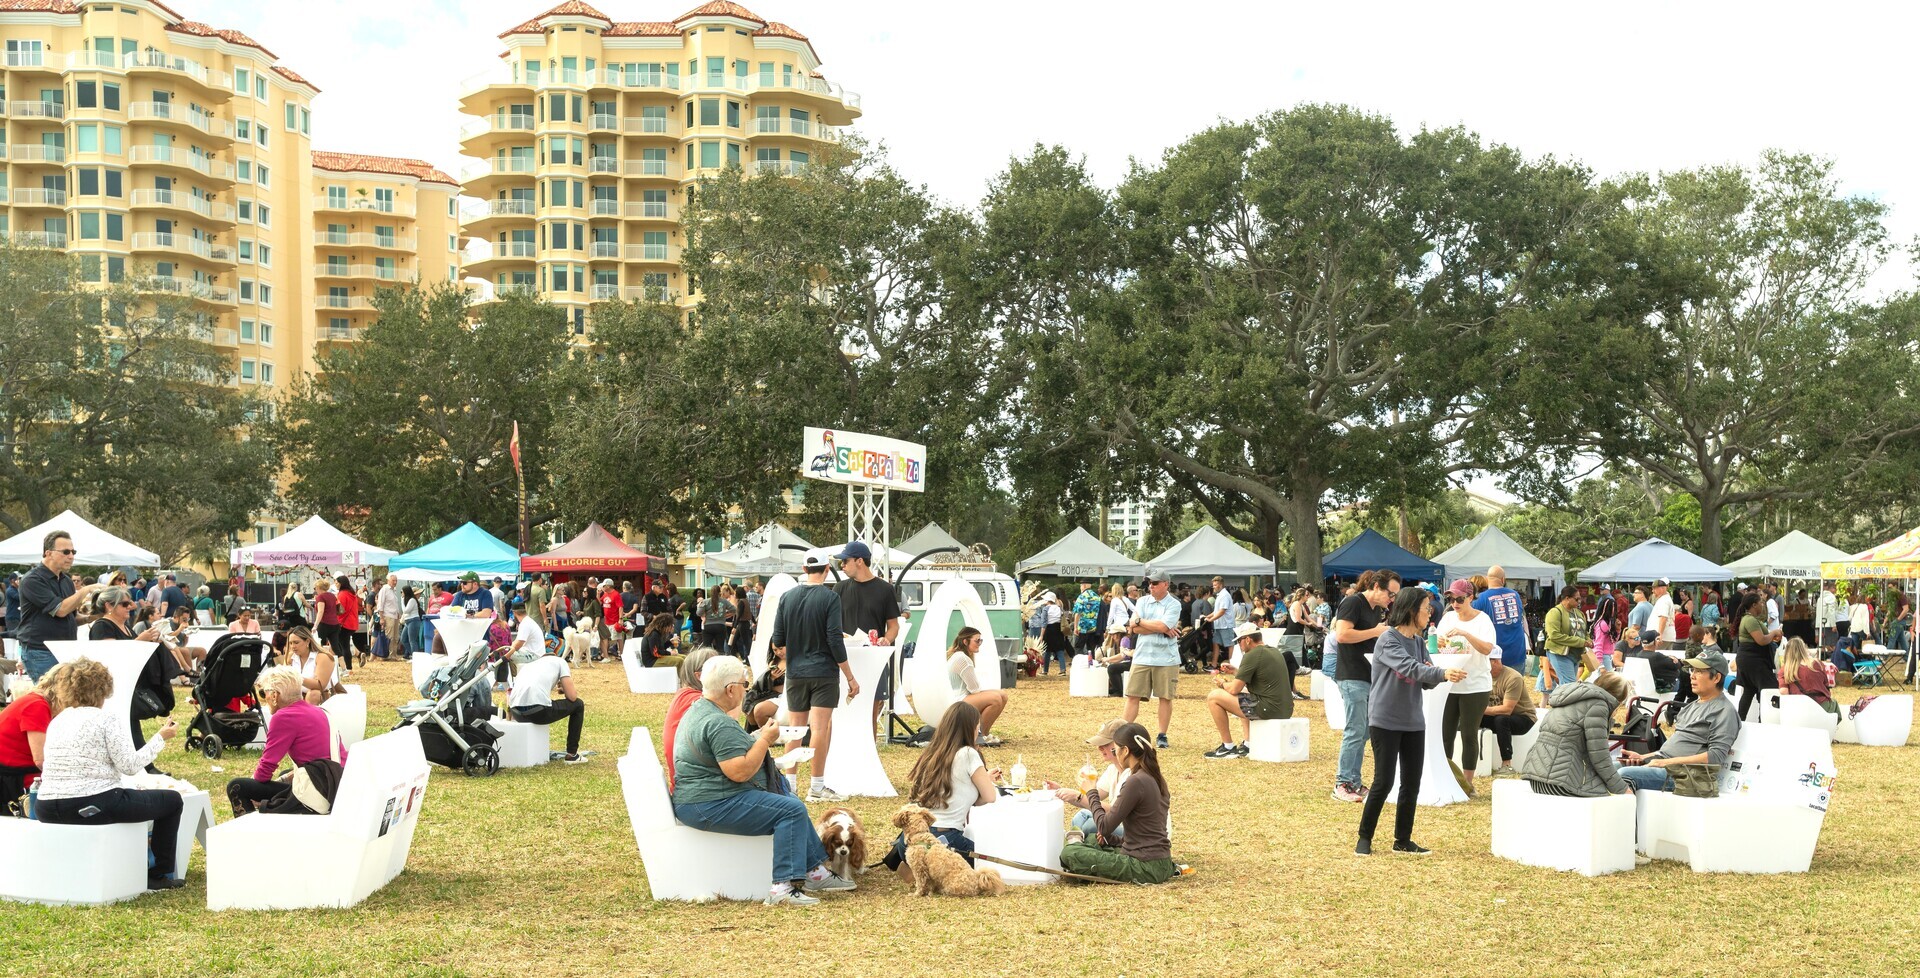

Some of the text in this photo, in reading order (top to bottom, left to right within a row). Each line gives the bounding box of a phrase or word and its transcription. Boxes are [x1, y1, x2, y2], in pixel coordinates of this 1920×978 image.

[300, 554, 309, 563] By
[561, 558, 605, 566] LICORICE
[607, 558, 628, 566] GUY
[1772, 568, 1788, 576] SHIVA
[1789, 569, 1807, 577] URBAN
[1845, 566, 1889, 575] 661-406-0051
[1585, 609, 1597, 622] 17
